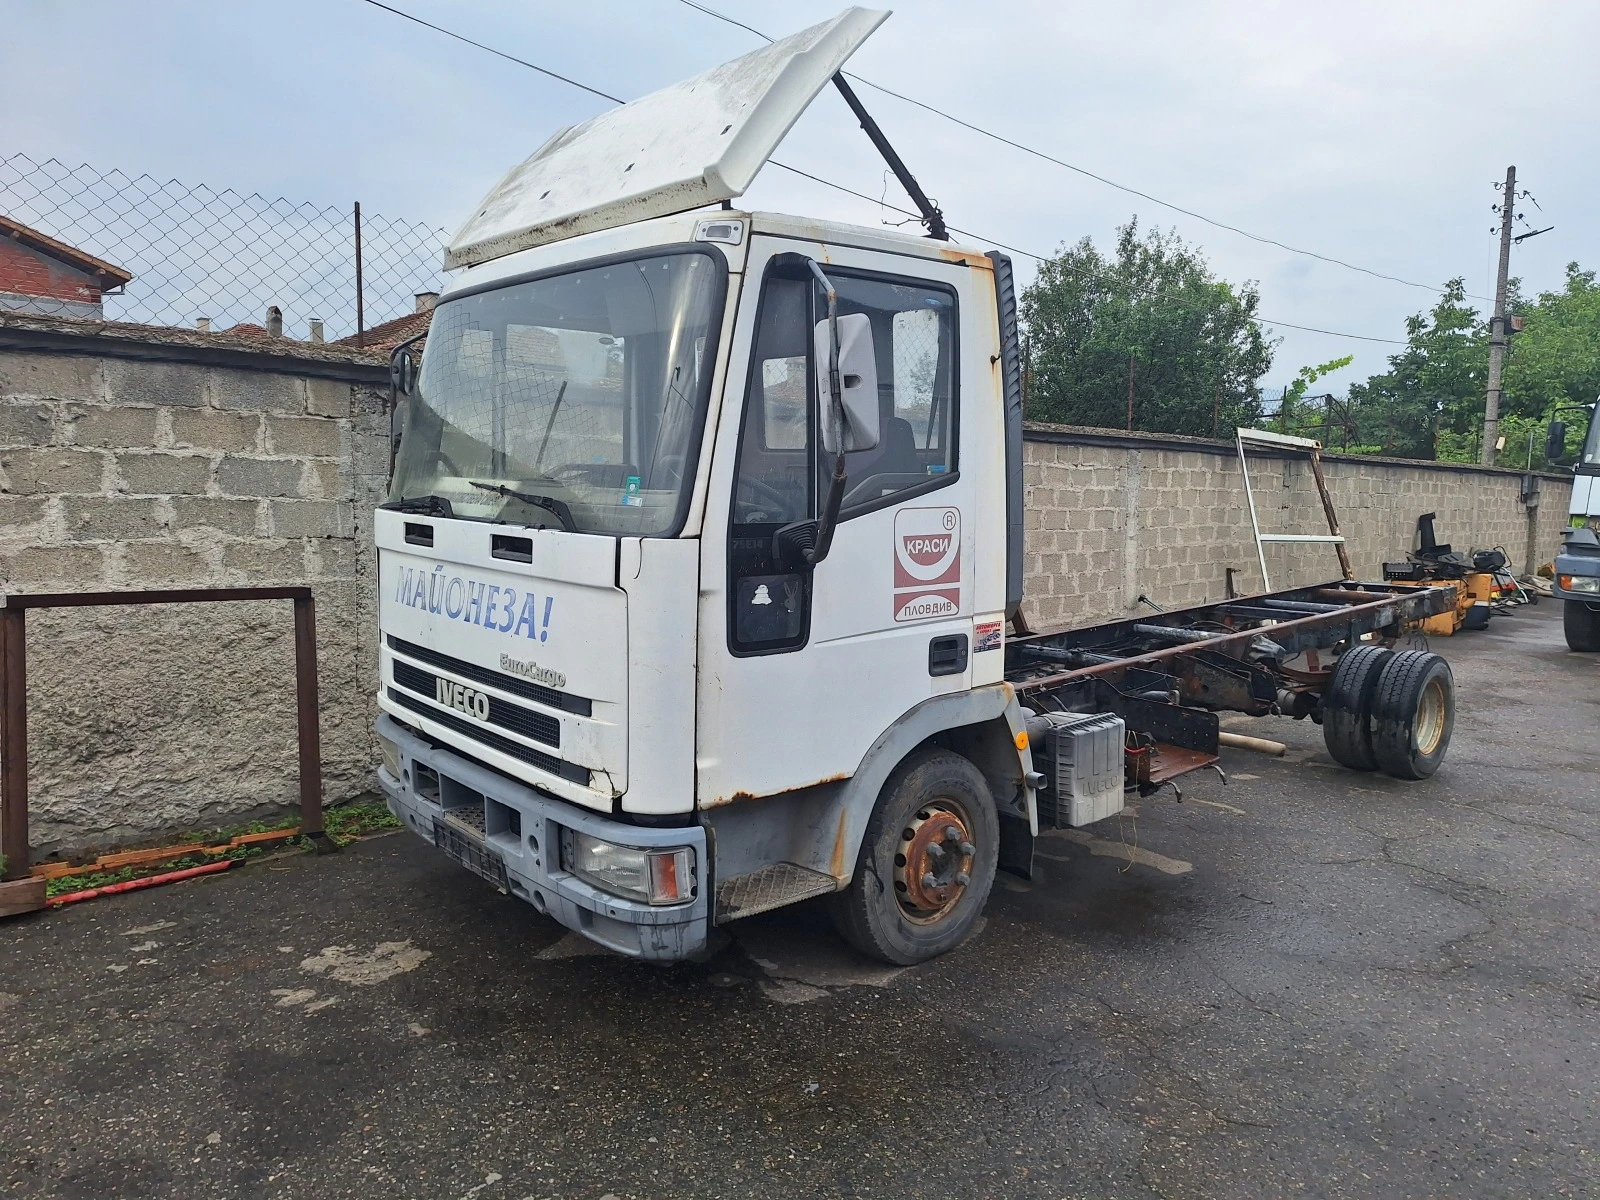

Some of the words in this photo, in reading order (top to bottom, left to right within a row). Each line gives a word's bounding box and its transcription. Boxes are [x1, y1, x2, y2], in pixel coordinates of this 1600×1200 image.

[906, 538, 949, 555] КРАСИ
[395, 564, 554, 643] МАЙОНЕЗА!
[904, 601, 953, 617] ПЛОВДИВ
[499, 652, 567, 688] EuroCargo
[435, 677, 490, 722] IVECO
[1082, 775, 1118, 797] IVECO
